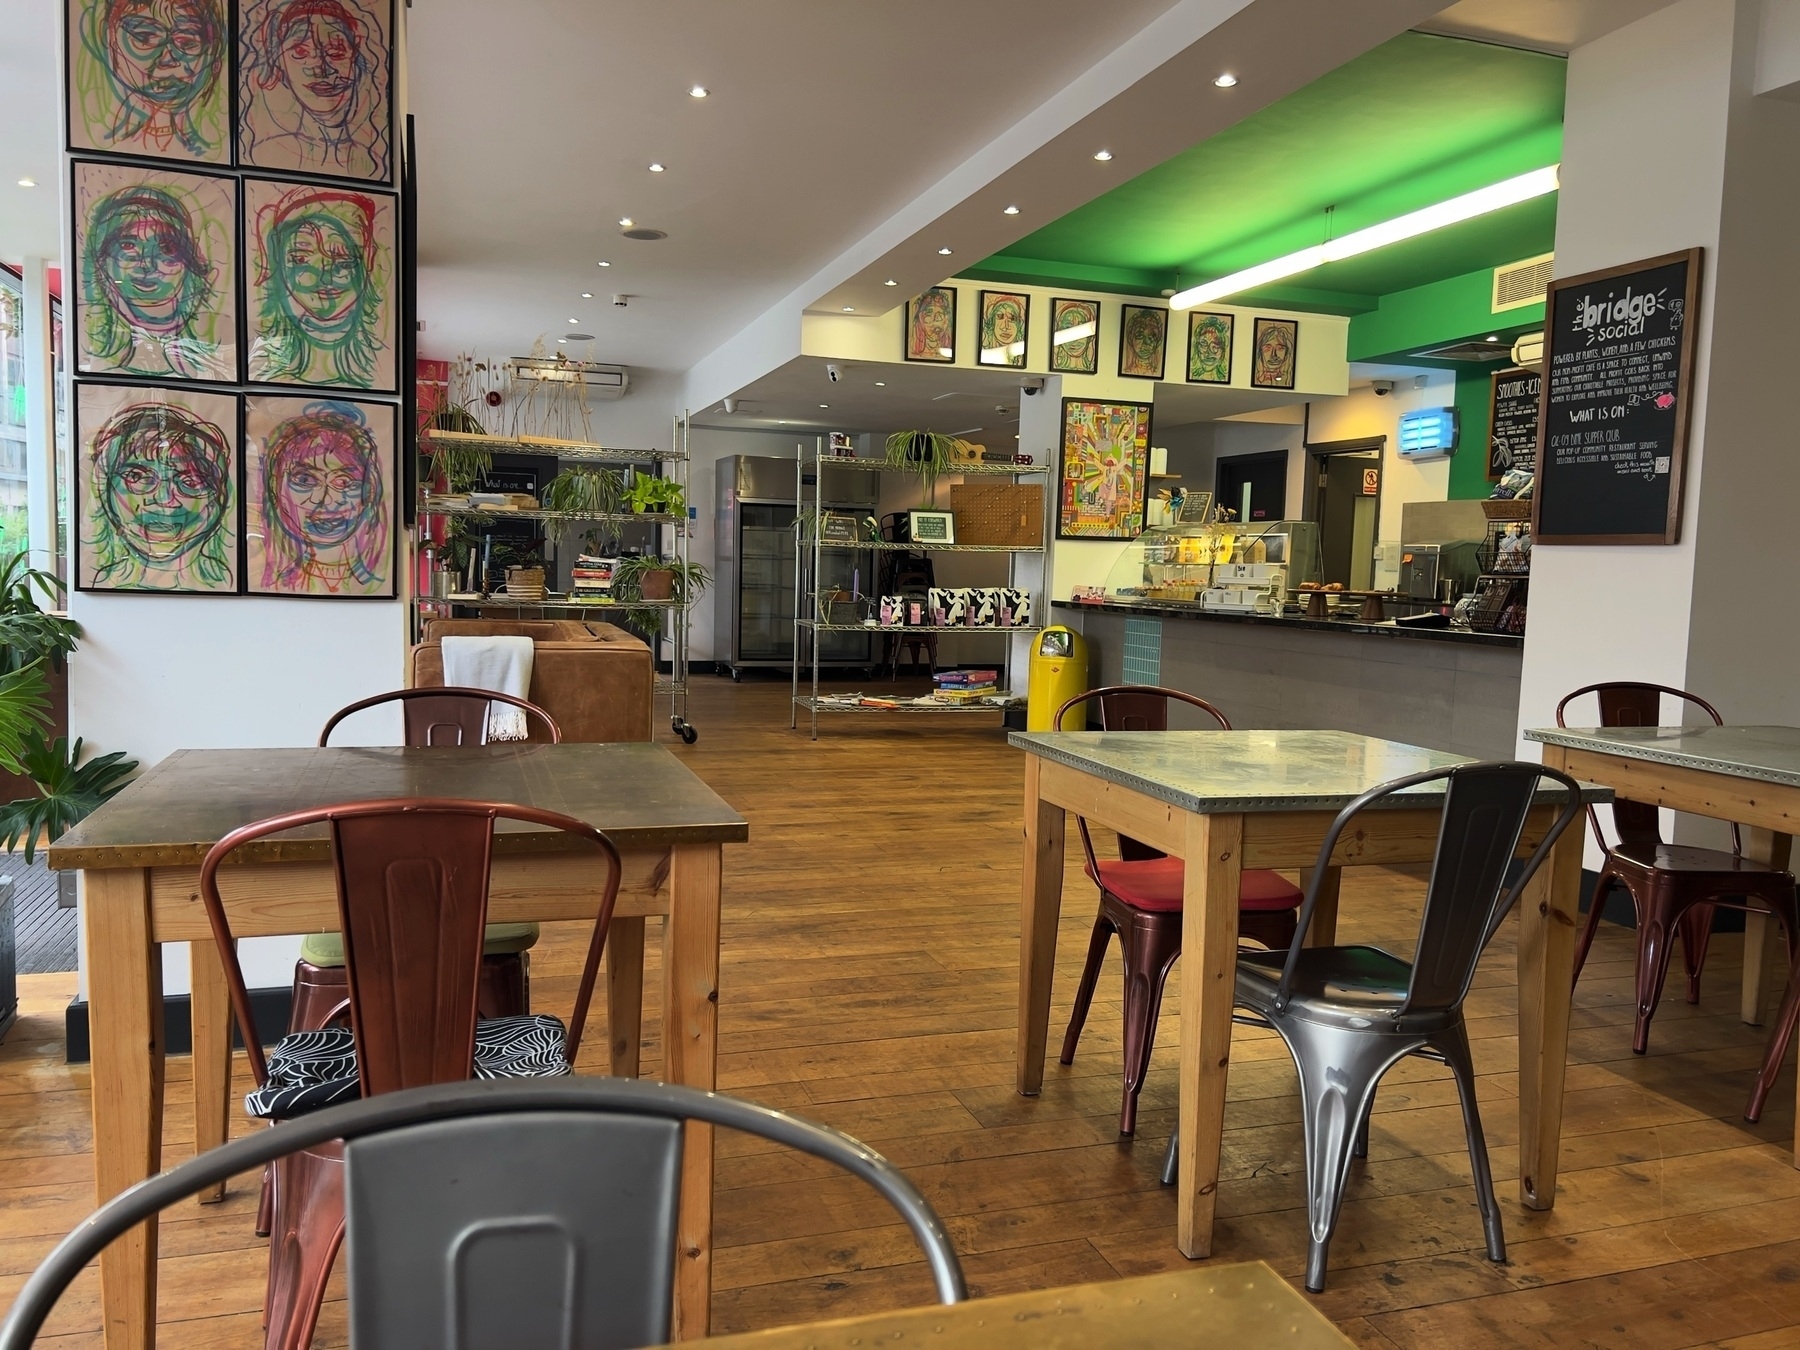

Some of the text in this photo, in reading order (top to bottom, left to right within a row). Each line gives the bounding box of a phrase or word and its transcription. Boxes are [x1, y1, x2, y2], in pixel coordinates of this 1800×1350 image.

[1572, 286, 1656, 332] the bridge
[1597, 316, 1645, 342] social
[1553, 353, 1575, 365] POWERED
[1575, 351, 1582, 362] BY
[1619, 343, 1629, 354] AND
[1634, 341, 1647, 351] FEW
[1647, 336, 1676, 349] CHICKENS
[1552, 368, 1561, 377] OUR
[1606, 359, 1620, 370] SPACE
[1621, 358, 1628, 367] TO
[1608, 368, 1623, 378] PROFIT
[1624, 366, 1637, 376] GOES
[1638, 364, 1651, 374] BACK
[1652, 362, 1664, 372] INTO
[1652, 371, 1666, 381] SPACE
[1569, 408, 1596, 423] WHAT
[1598, 406, 1608, 420] IS
[1584, 430, 1605, 445] SUPPER
[1605, 428, 1621, 443] CLUB
[1556, 448, 1565, 456] OUR
[1582, 444, 1607, 454] COMMUNITY
[1609, 442, 1637, 452] RESTAURANT
[1639, 441, 1659, 450] SERVING
[1610, 452, 1637, 461] SUSTAINABLE
[1640, 451, 1653, 459] FOOD
